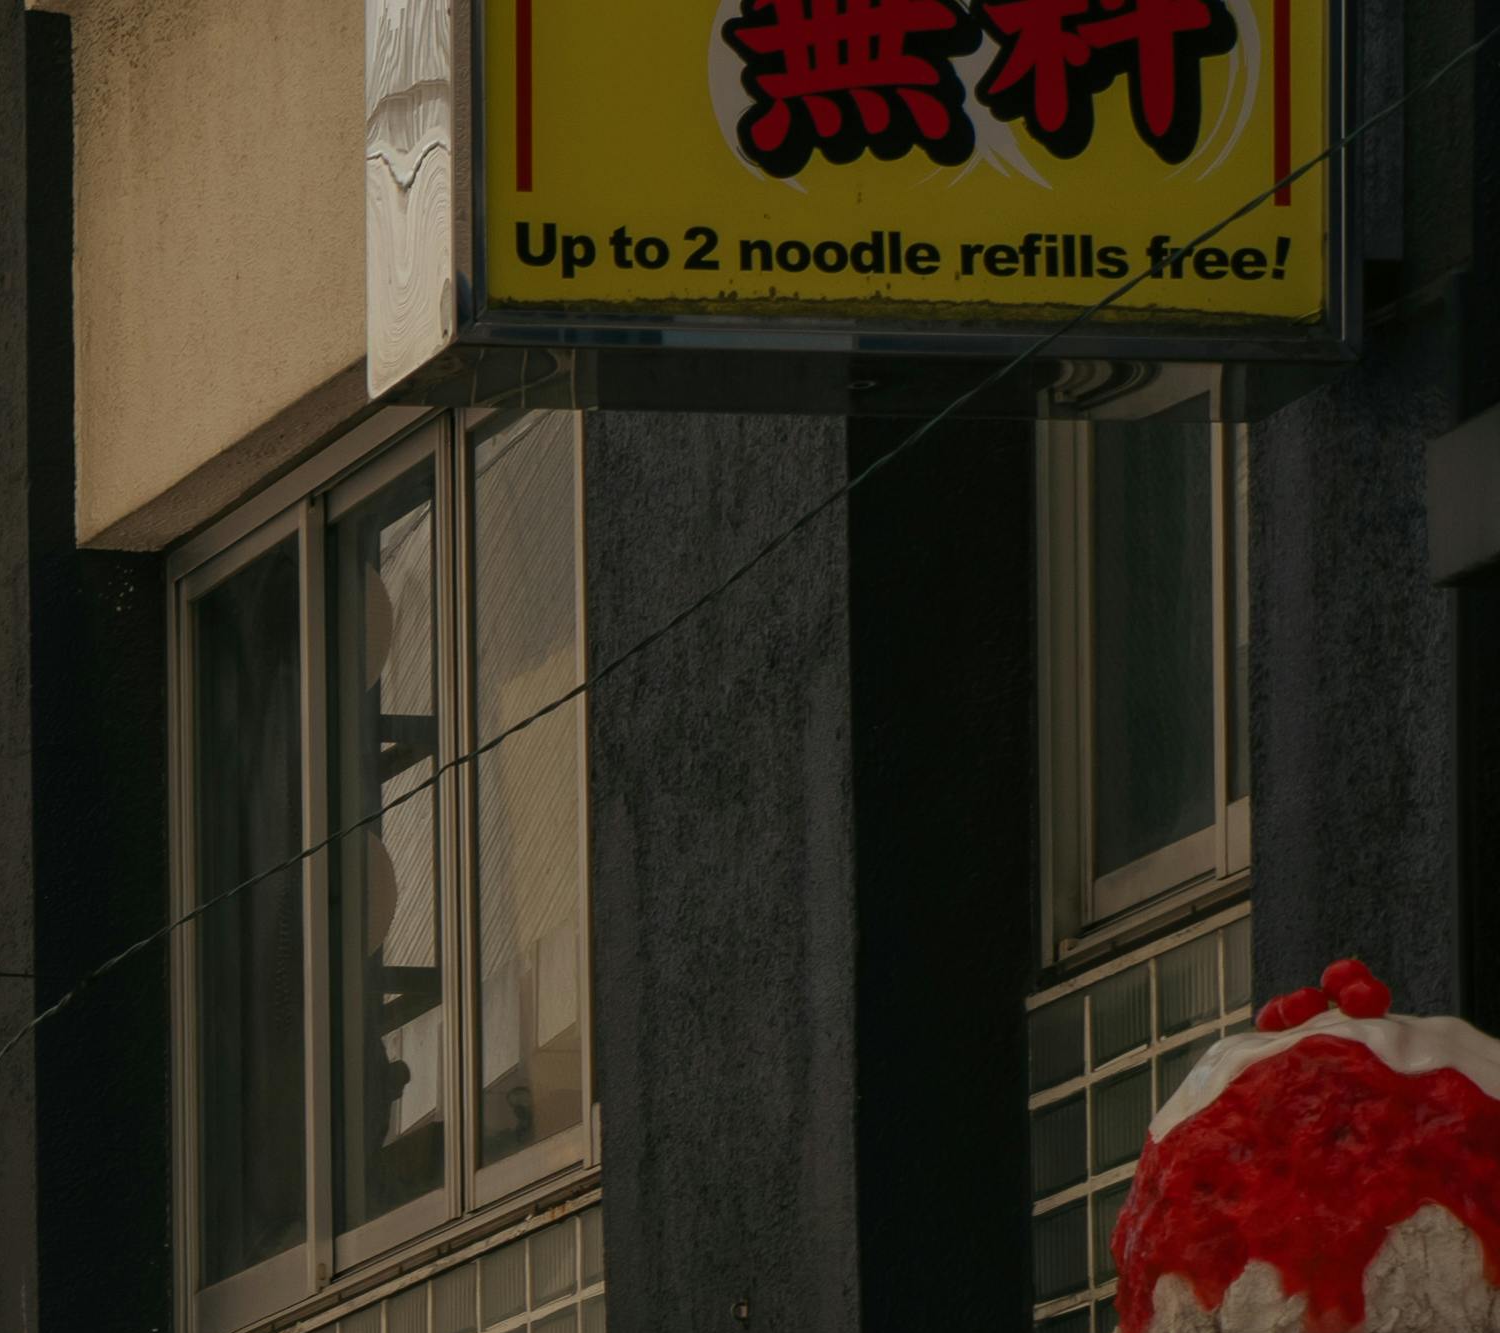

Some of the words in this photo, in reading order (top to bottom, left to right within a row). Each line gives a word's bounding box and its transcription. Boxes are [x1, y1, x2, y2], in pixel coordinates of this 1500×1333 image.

[515, 221, 596, 278] Up
[609, 226, 670, 270] to
[683, 226, 721, 271] 2
[738, 231, 941, 275] noodle
[960, 233, 1129, 279] refills
[1147, 235, 1291, 280] free!
